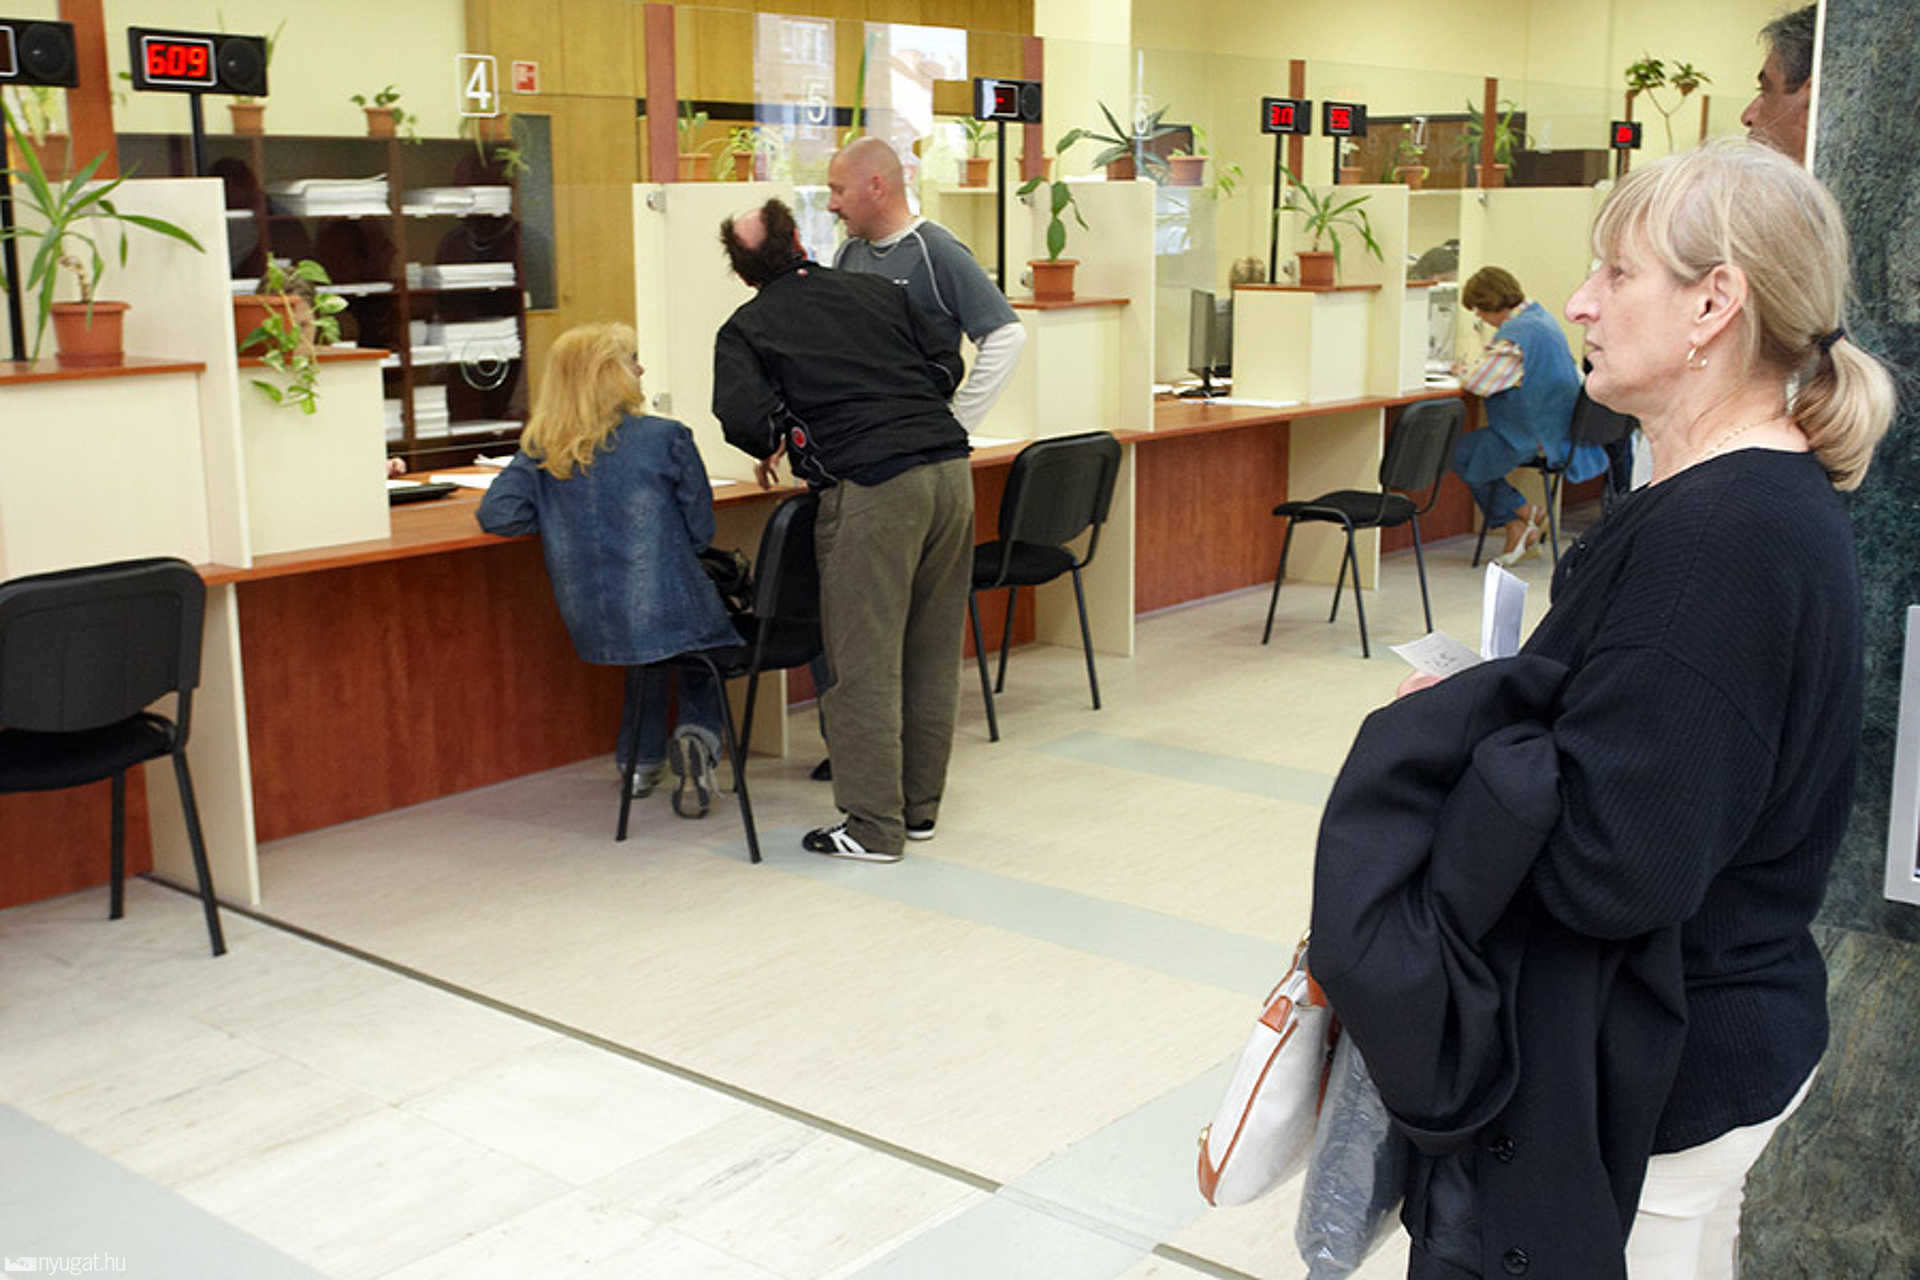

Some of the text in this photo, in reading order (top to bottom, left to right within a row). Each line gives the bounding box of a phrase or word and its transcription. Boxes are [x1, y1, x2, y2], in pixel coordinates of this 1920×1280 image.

[147, 43, 208, 77] 609
[464, 61, 492, 109] 4
[807, 84, 826, 123] 5
[1415, 117, 1426, 144] 7
